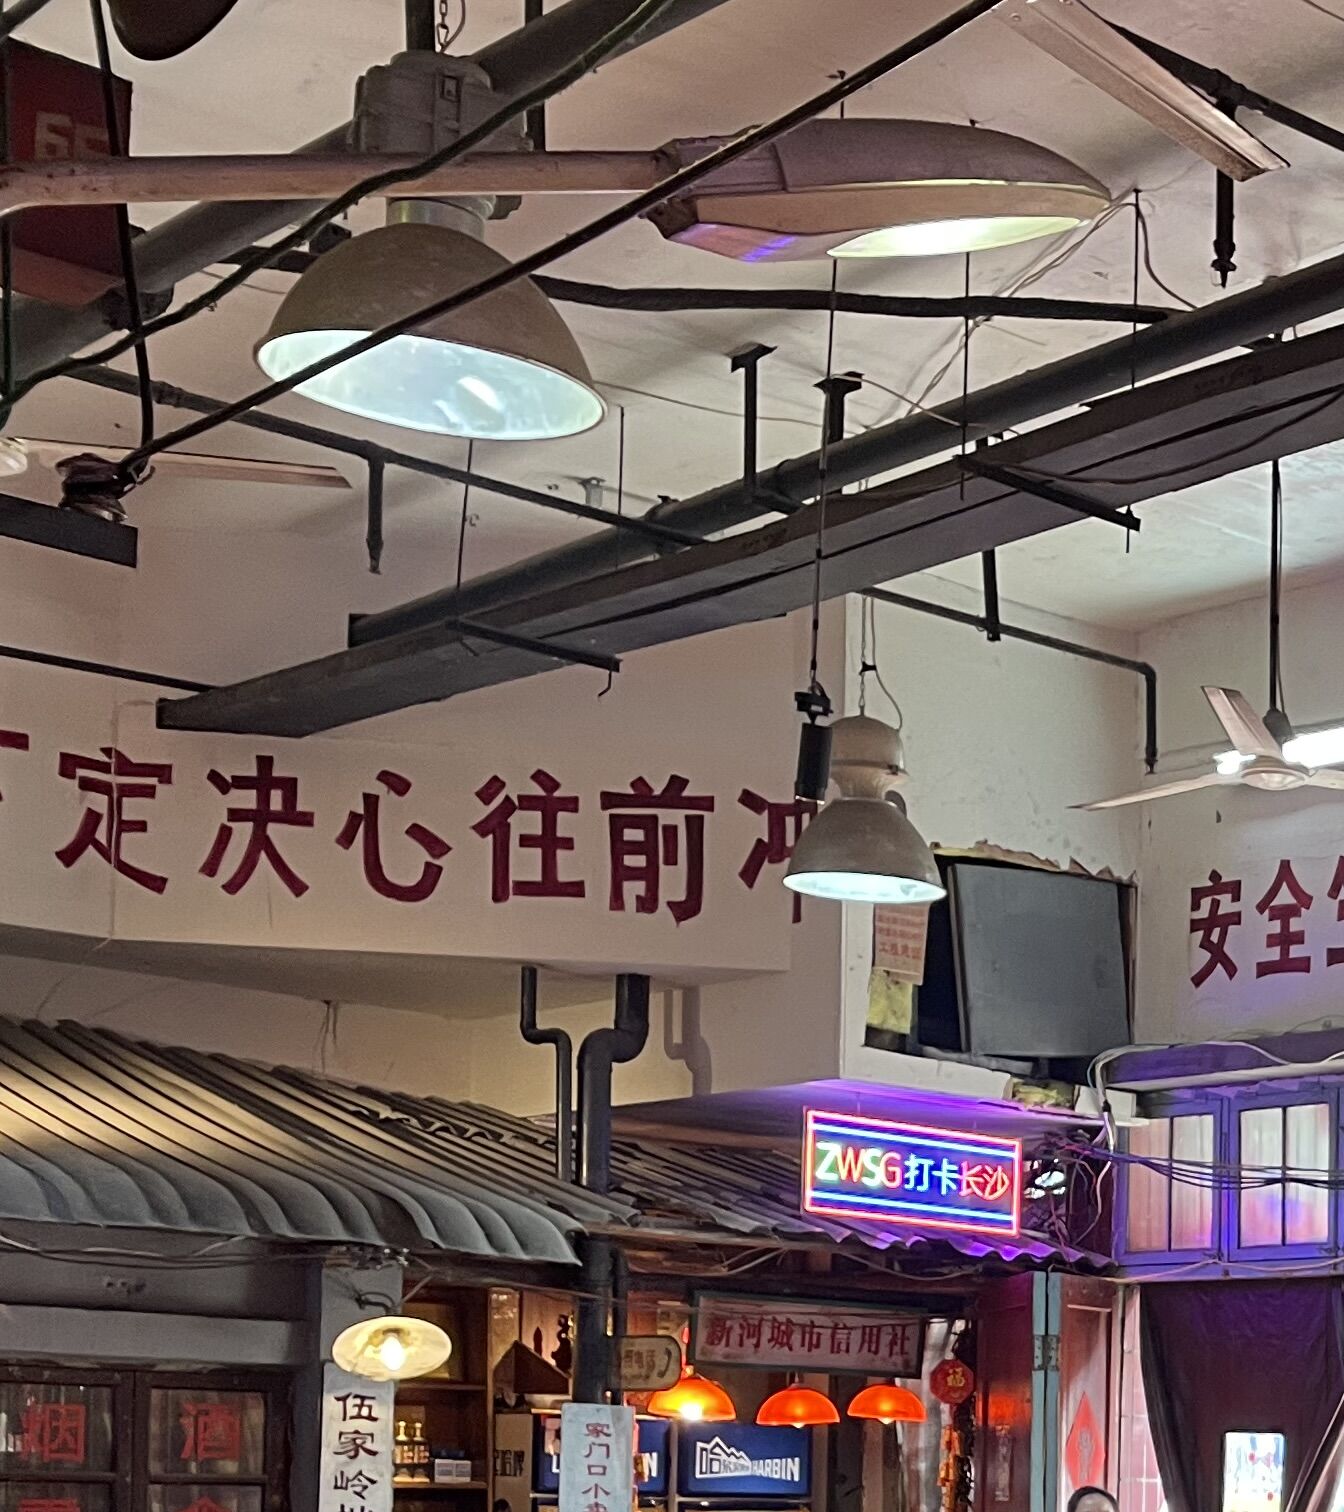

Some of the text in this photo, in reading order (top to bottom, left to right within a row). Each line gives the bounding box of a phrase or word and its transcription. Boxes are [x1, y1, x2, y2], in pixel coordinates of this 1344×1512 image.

[0, 728, 818, 924] 定决心往前冲
[815, 1141, 1010, 1201] ZWSG 打卡长沙
[704, 1315, 912, 1358] 新河城市信用社
[19, 1401, 242, 1463] 烟 酒
[751, 1457, 800, 1482] HARBIN
